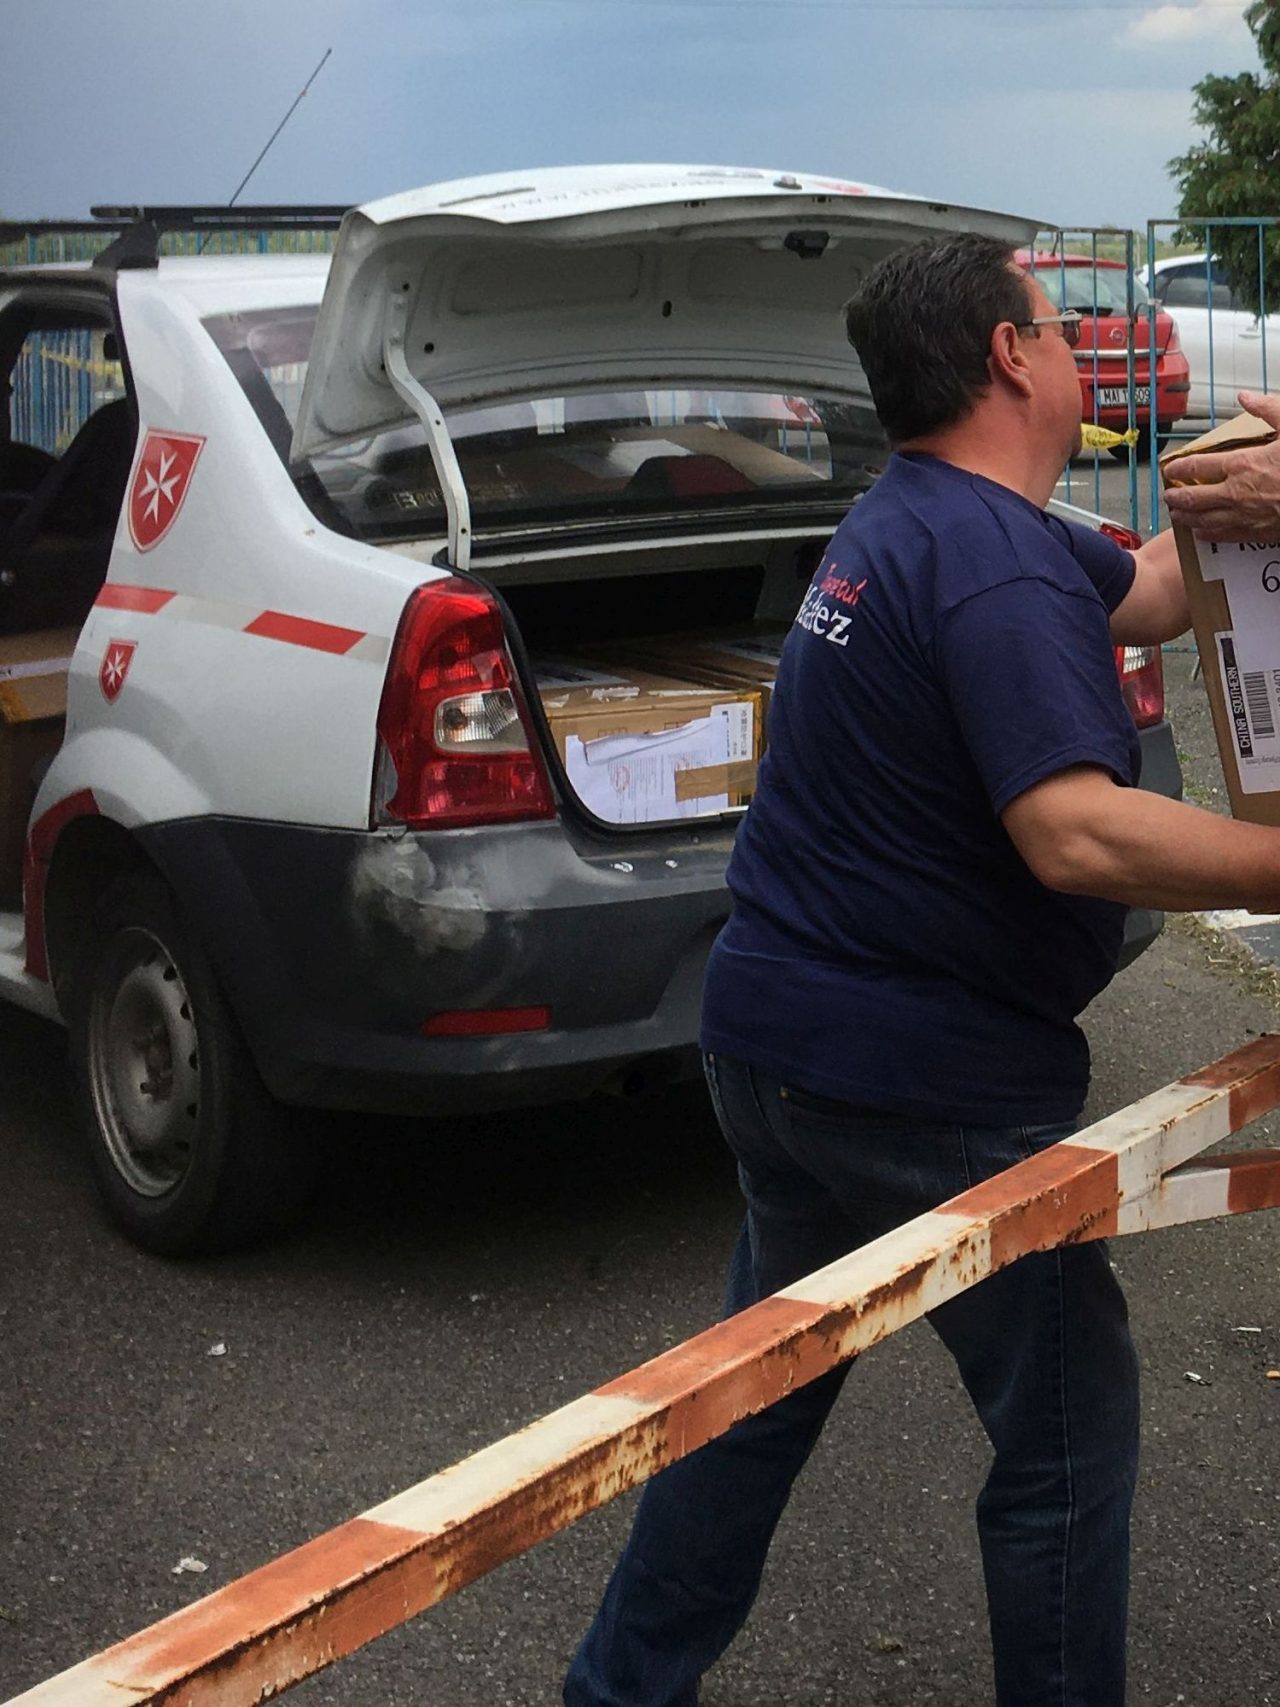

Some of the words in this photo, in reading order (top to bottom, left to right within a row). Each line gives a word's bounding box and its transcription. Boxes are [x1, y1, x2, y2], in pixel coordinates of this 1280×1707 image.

[1103, 388, 1120, 403] MAI
[1227, 666, 1244, 714] SOUTHERN
[1236, 718, 1251, 748] CHINA
